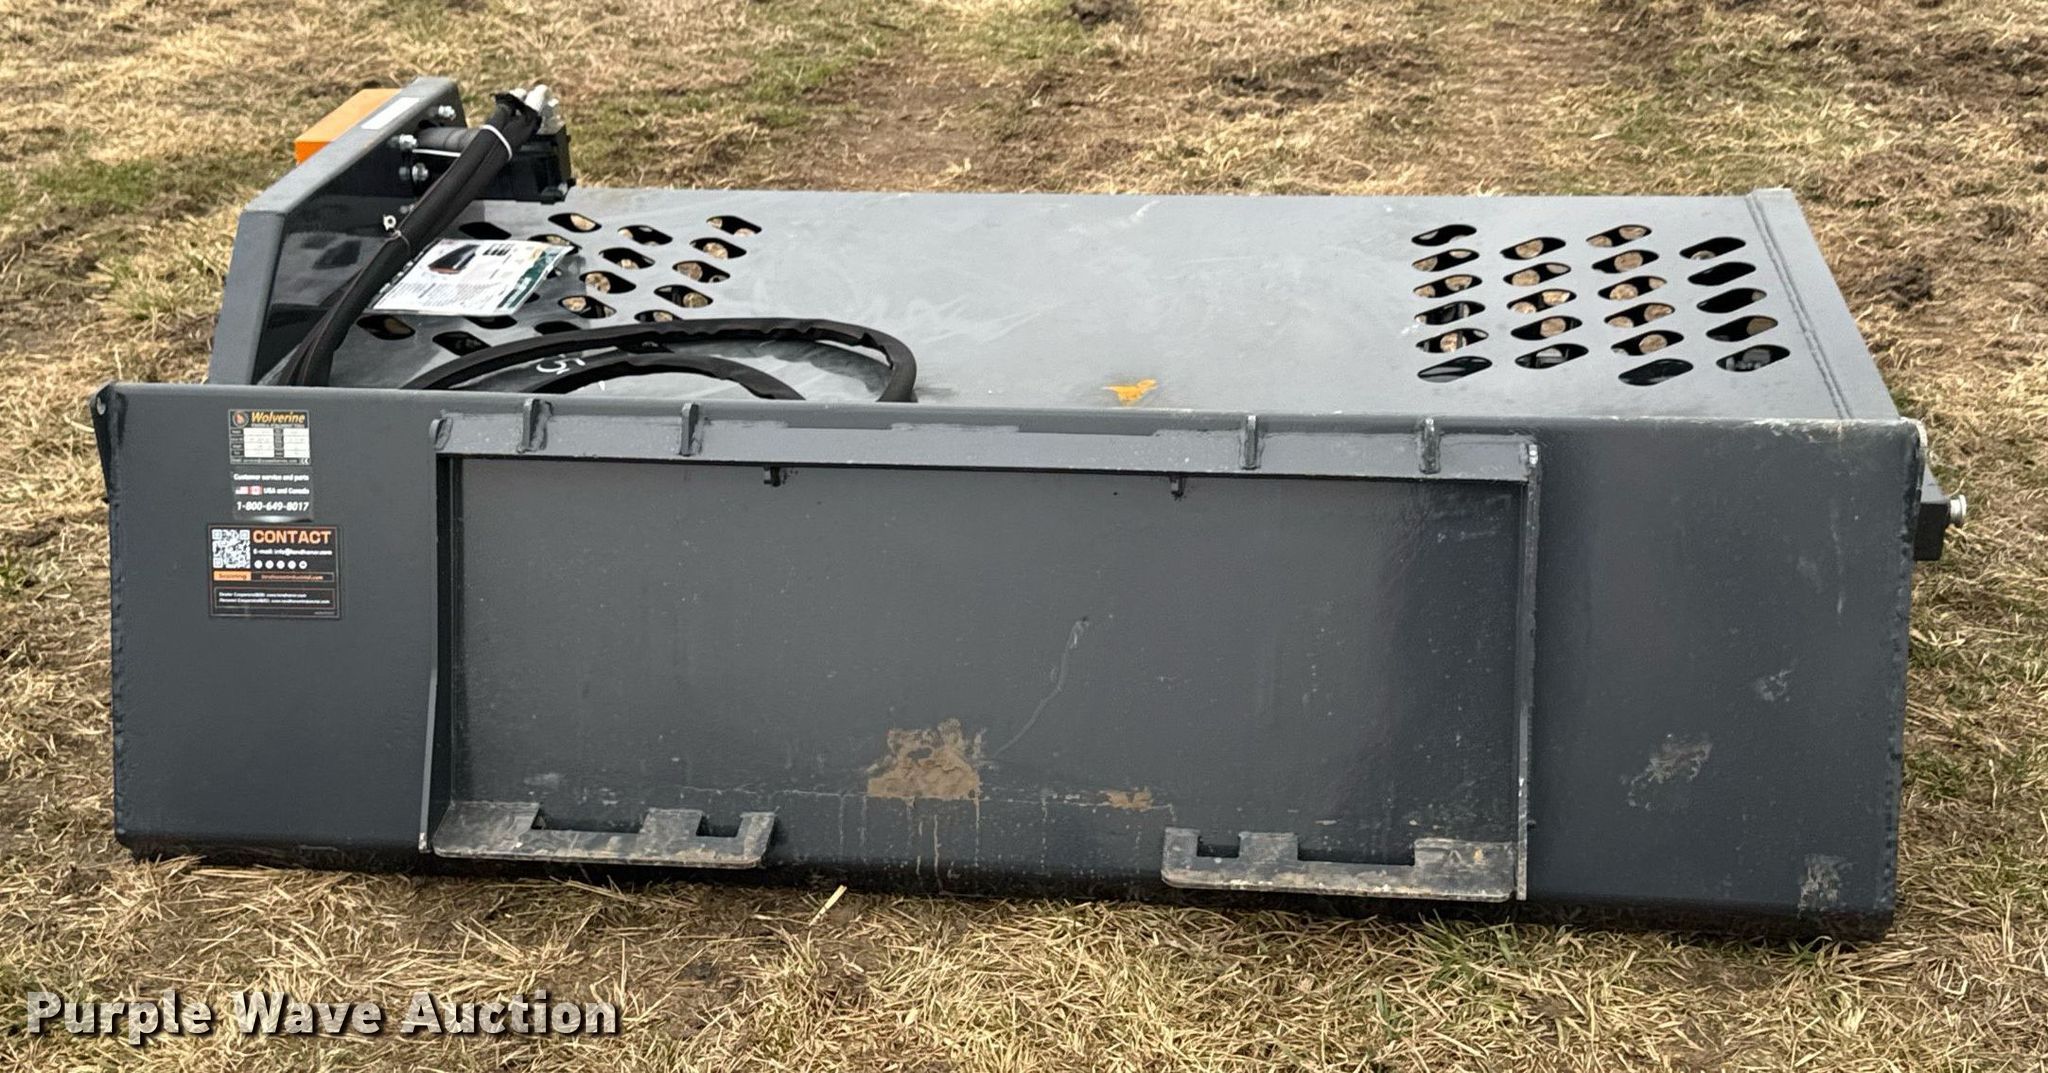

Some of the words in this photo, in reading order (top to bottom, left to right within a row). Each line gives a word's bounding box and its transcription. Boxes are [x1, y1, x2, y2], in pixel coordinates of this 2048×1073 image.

[251, 411, 305, 423] Wolverine
[233, 473, 260, 481] Customer
[294, 474, 309, 482] parts
[236, 501, 309, 512] 1-800-649-8017
[252, 530, 331, 544] CONTACT
